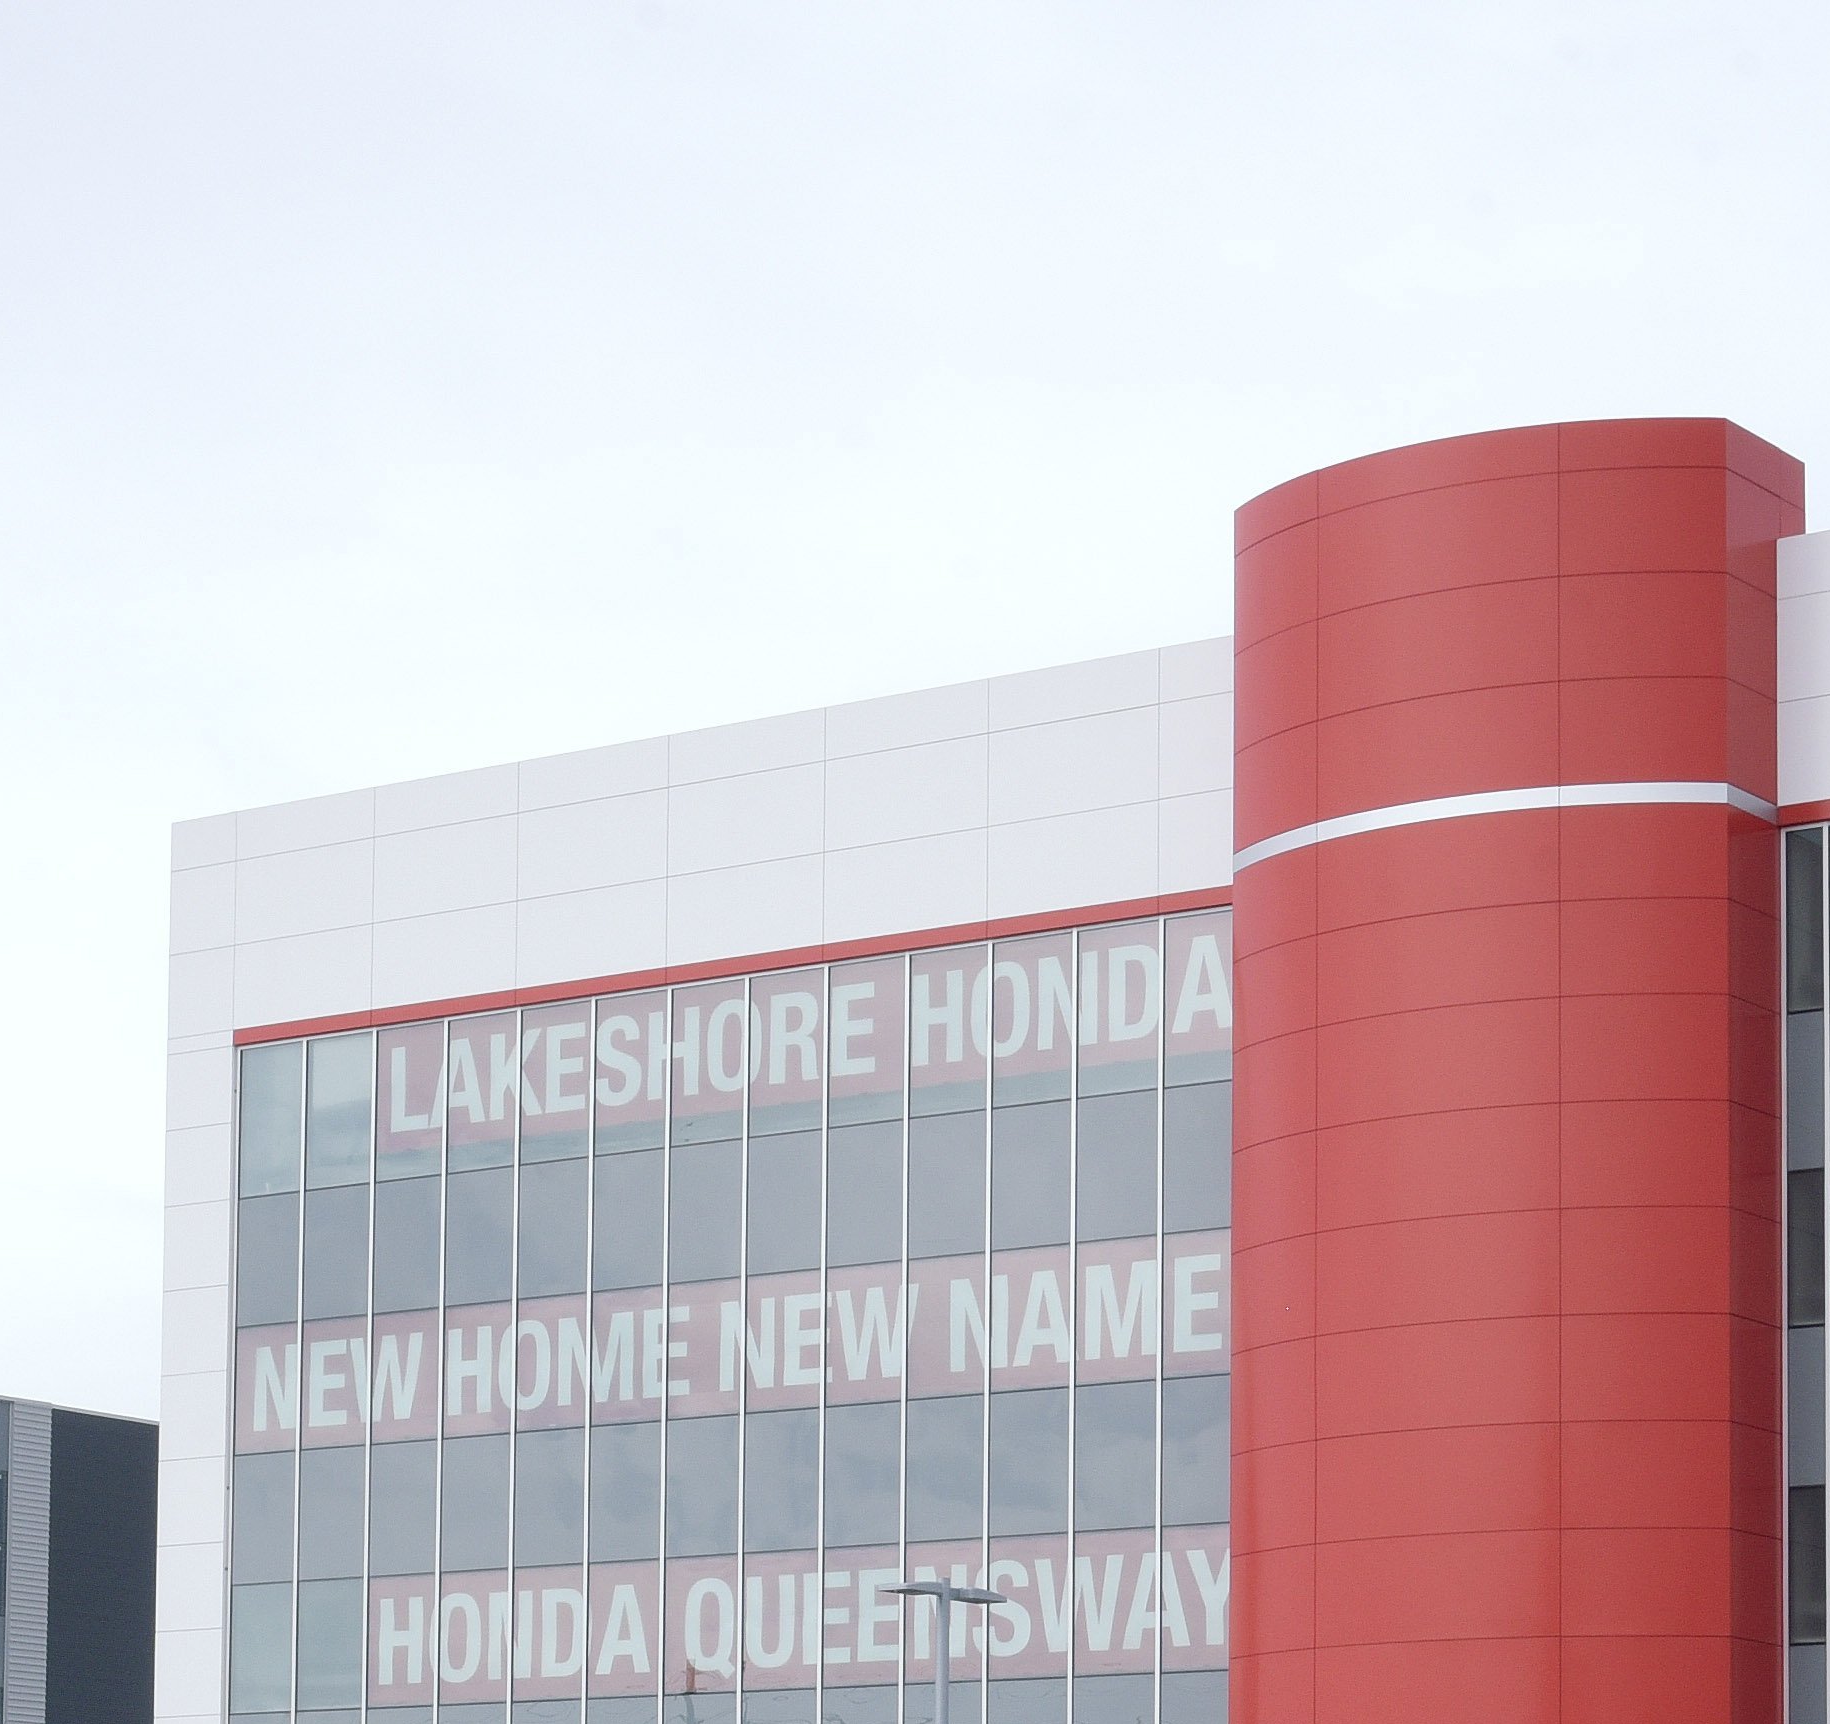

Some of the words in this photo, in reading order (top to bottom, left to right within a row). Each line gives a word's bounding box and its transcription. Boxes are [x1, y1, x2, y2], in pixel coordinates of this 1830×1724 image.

[388, 979, 877, 1135] LAKESHORE
[911, 933, 1233, 1068] HONDA
[252, 1329, 423, 1433] NEW
[448, 1305, 691, 1416] HOME
[719, 1282, 920, 1394] NEW
[948, 1252, 1223, 1374] NAME
[378, 1581, 650, 1685] HONDA
[682, 1546, 1229, 1680] QUEENSWAY
